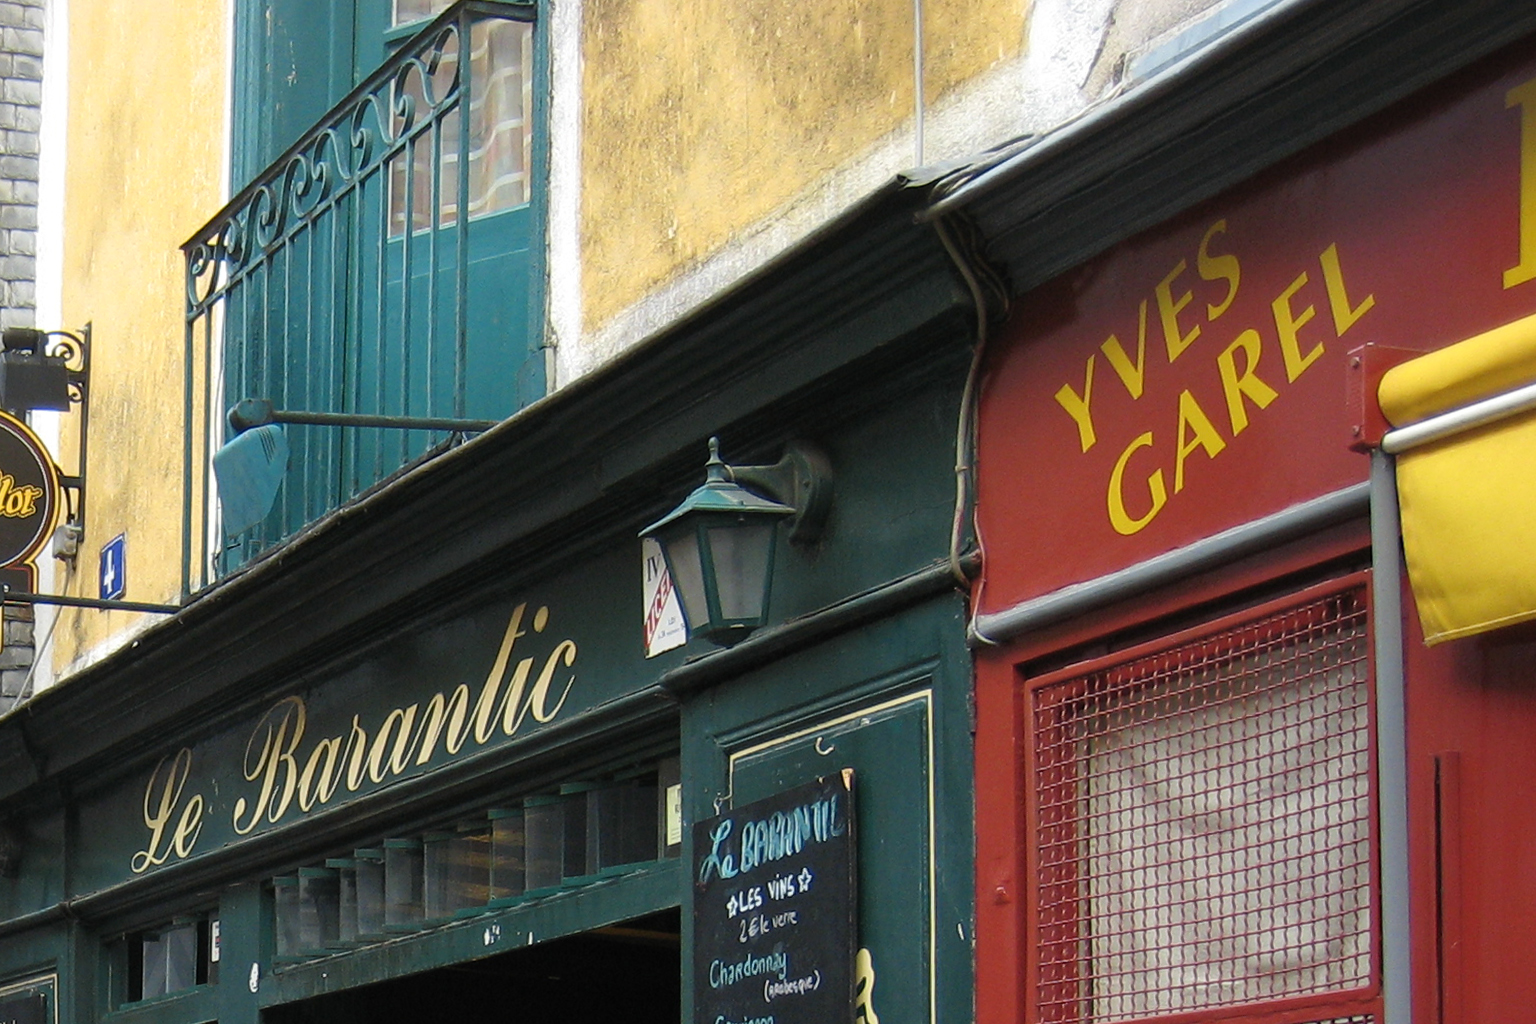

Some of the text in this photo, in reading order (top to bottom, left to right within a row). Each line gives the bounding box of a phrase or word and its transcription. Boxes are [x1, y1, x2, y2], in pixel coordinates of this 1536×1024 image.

[1054, 219, 1241, 453] YVES
[1106, 242, 1375, 536] GAREL
[102, 550, 115, 593] 4
[130, 601, 578, 874] Le Barantic
[699, 818, 739, 884] Le
[739, 886, 763, 913] LES
[772, 910, 798, 928] verre
